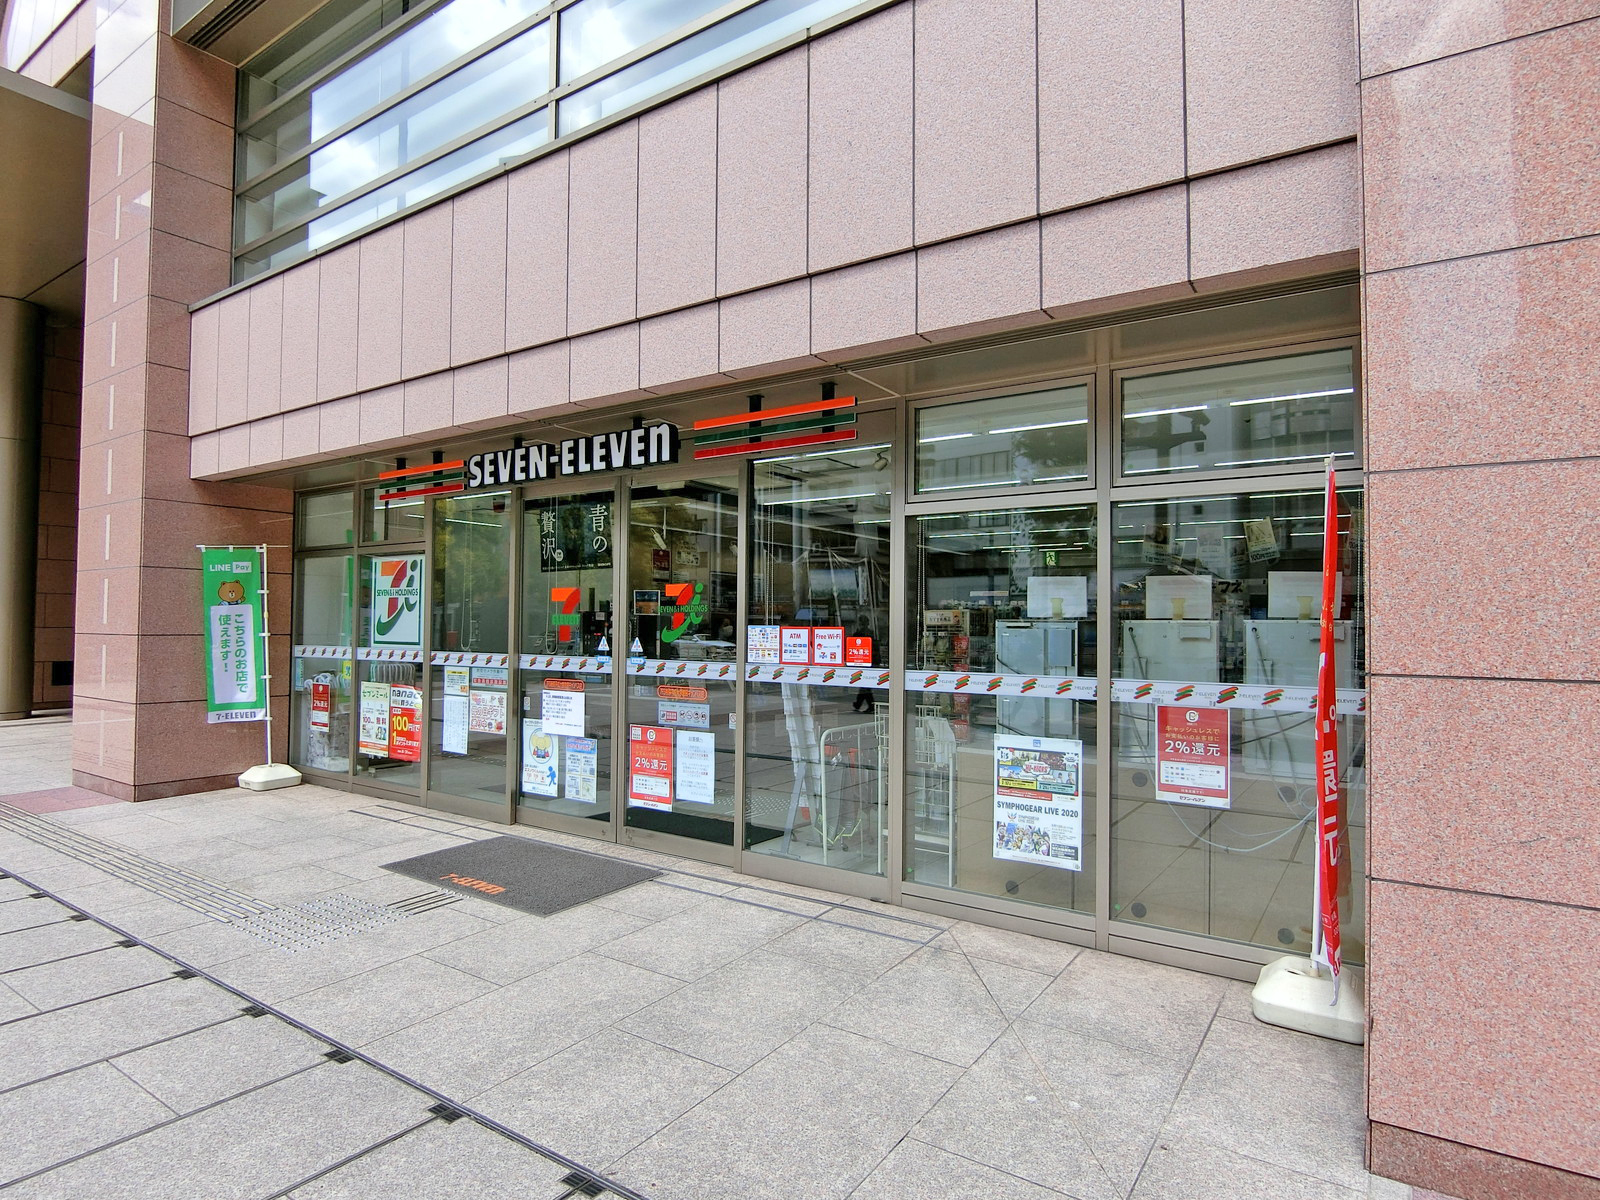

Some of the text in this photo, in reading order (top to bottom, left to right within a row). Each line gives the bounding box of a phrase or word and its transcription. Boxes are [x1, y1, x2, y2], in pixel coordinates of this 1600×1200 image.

[588, 504, 608, 553] 青の
[209, 563, 250, 572] LINE Pay
[395, 588, 419, 597] HOLDINGS
[681, 605, 708, 613] HOLDINGS
[234, 613, 248, 693] こちらのお店で
[1165, 740, 1221, 757] 2%還元
[635, 756, 668, 771] 2%還元
[996, 801, 1079, 818] SYMPHOGEAR LIVE 2020
